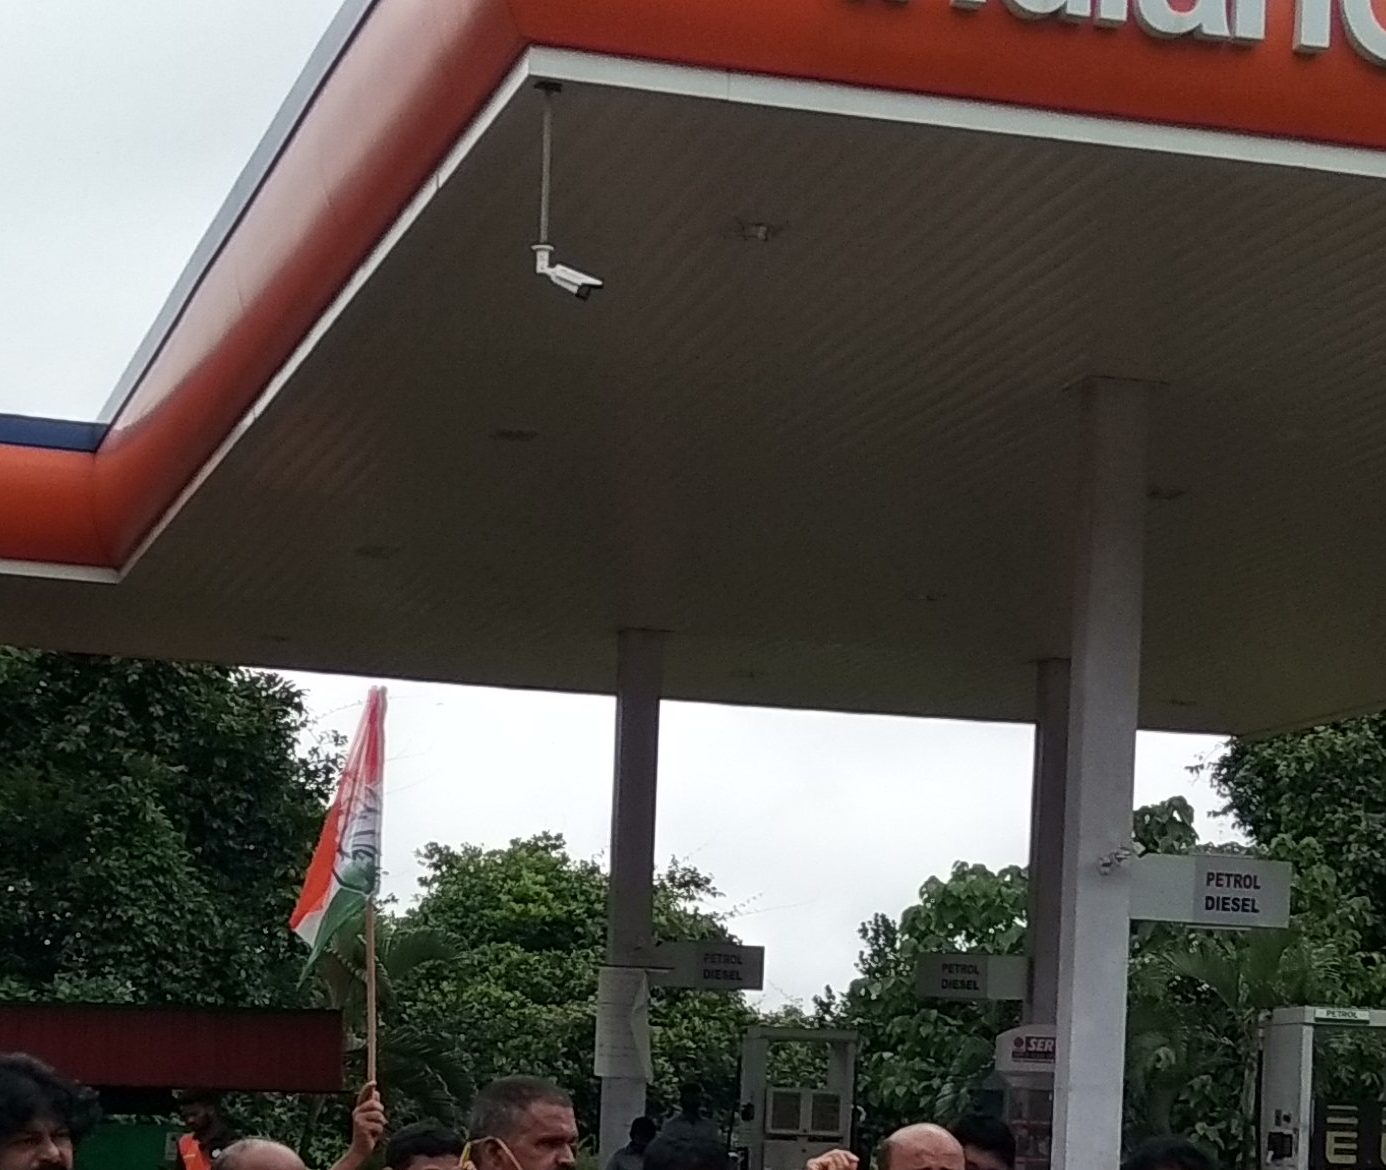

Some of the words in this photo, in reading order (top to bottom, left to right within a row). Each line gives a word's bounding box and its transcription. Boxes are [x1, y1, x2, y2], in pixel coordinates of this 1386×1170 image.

[1206, 872, 1261, 889] PETROL
[1205, 896, 1259, 913] DIESEL
[703, 969, 742, 981] DIESEL
[942, 963, 979, 975] PETROL
[941, 979, 979, 990] DIESEL
[1326, 1009, 1358, 1019] PETROL
